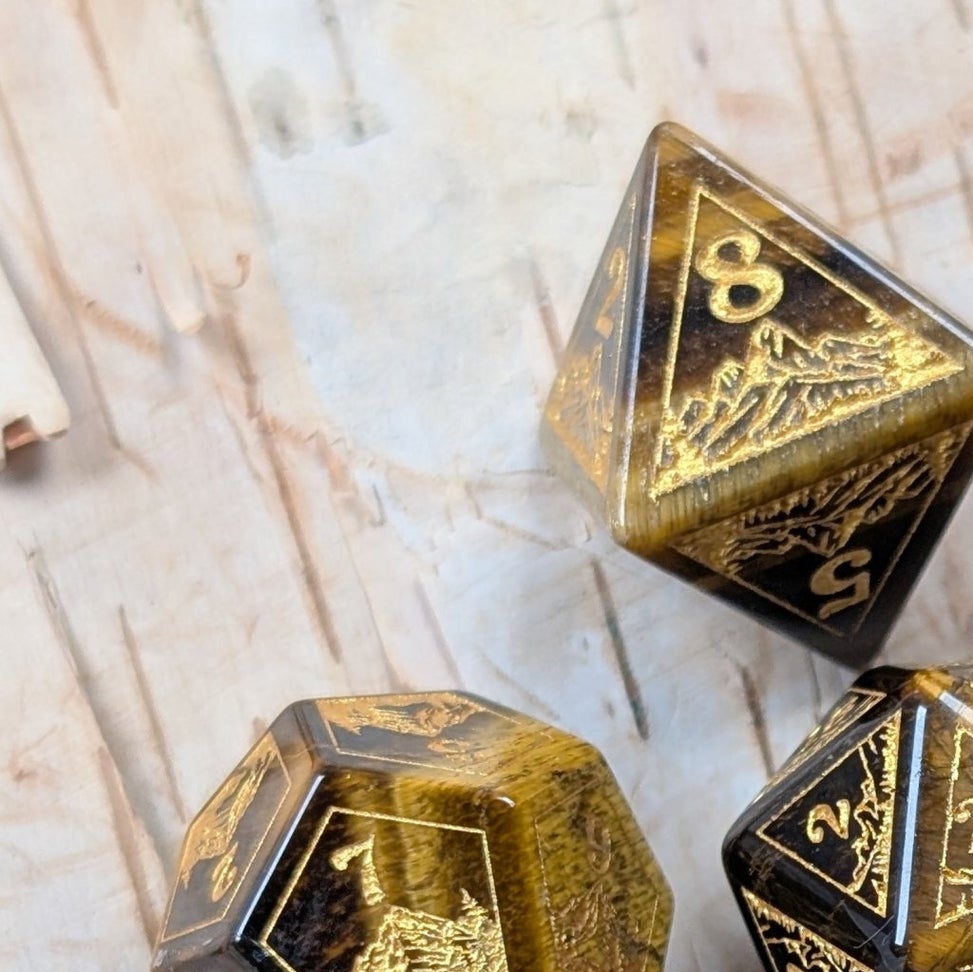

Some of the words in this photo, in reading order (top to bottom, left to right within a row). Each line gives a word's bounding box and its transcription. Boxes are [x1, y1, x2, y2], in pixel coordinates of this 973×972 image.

[696, 231, 784, 324] 8
[809, 547, 872, 619] 5
[806, 798, 850, 844] 2
